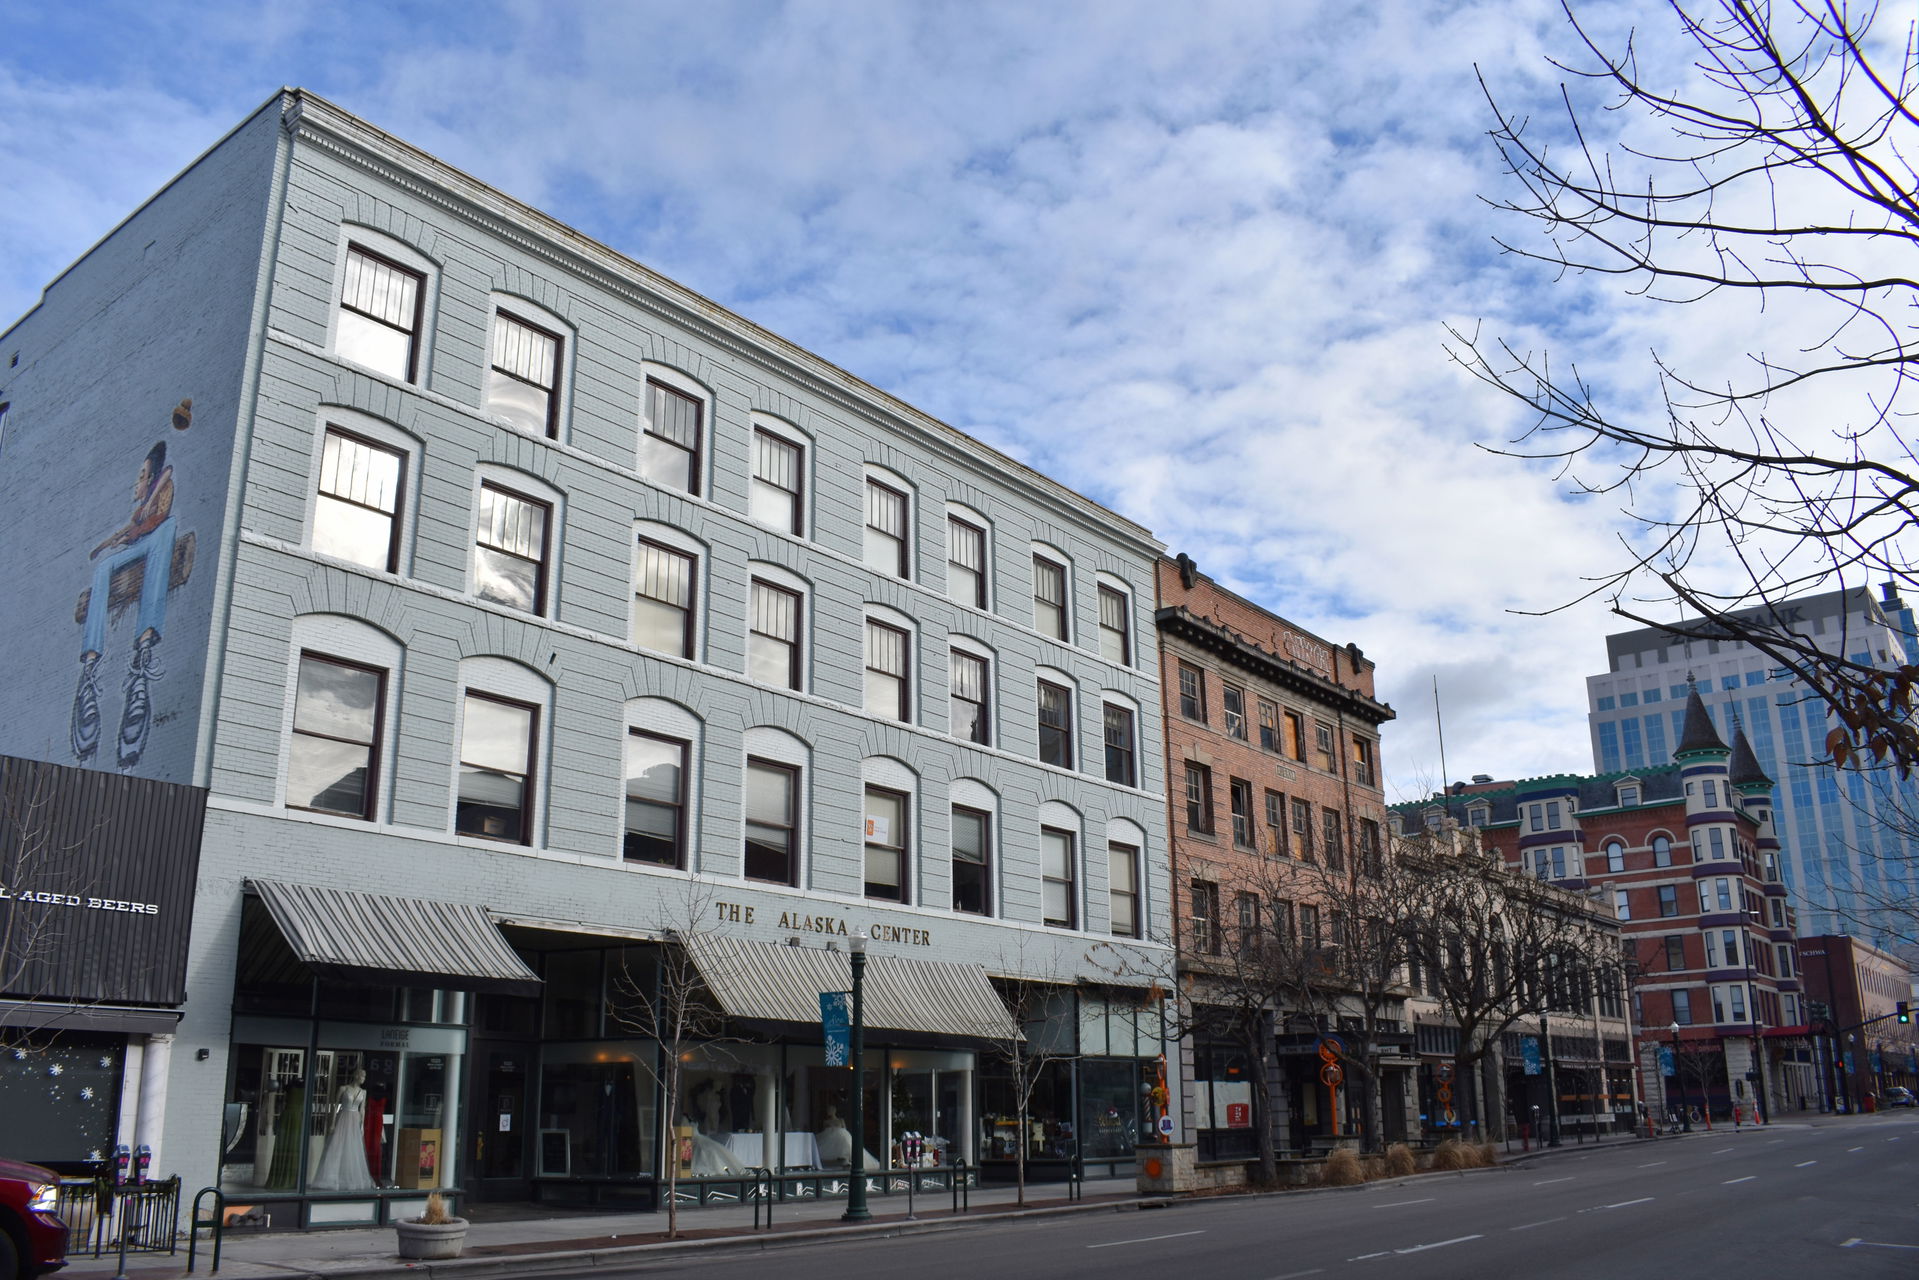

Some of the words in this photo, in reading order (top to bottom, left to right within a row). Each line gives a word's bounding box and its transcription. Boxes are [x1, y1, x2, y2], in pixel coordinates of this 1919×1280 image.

[87, 897, 159, 915] BEERS
[715, 902, 755, 924] THE
[778, 911, 849, 936] ALASKA
[871, 924, 931, 946] CENTER
